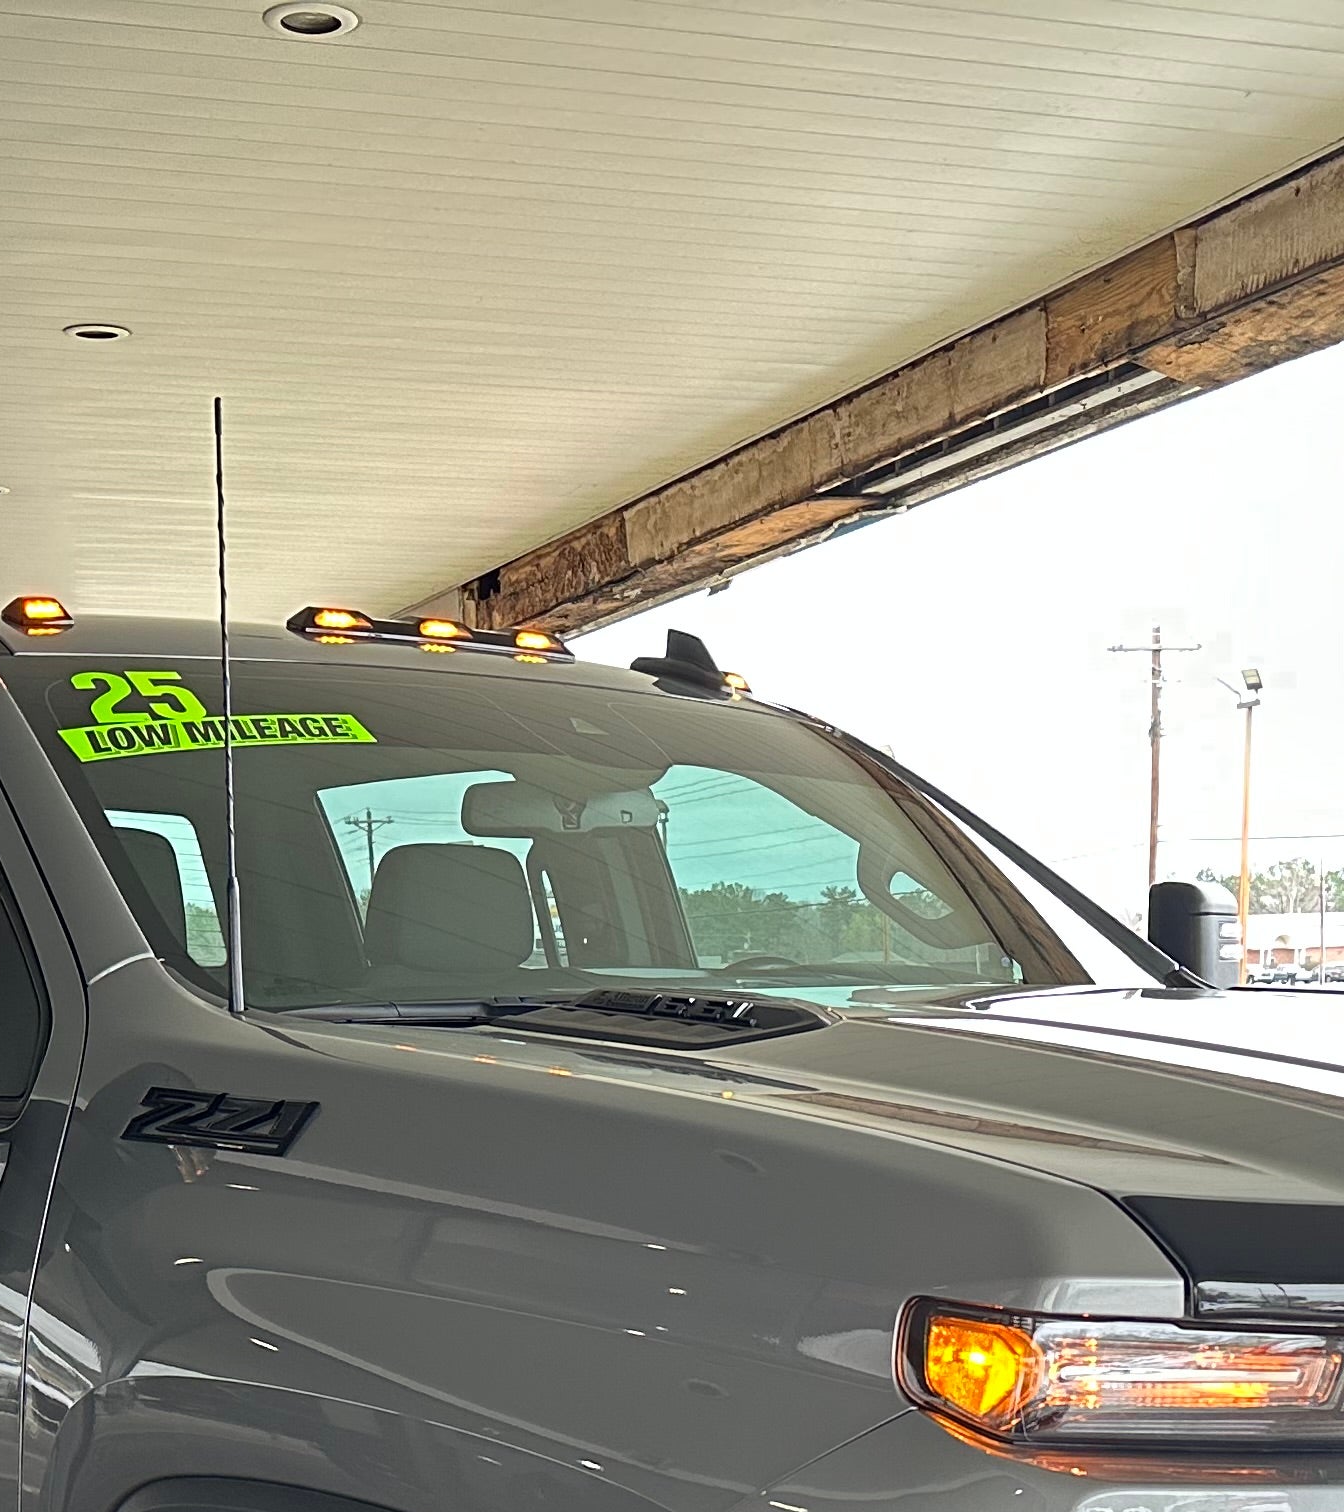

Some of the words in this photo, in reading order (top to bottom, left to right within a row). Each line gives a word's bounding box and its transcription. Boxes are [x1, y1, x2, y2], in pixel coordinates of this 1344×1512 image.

[70, 670, 207, 723] 25
[86, 721, 176, 754] LOW
[181, 716, 350, 745] MILEAGE
[120, 1086, 321, 1157] Z71
